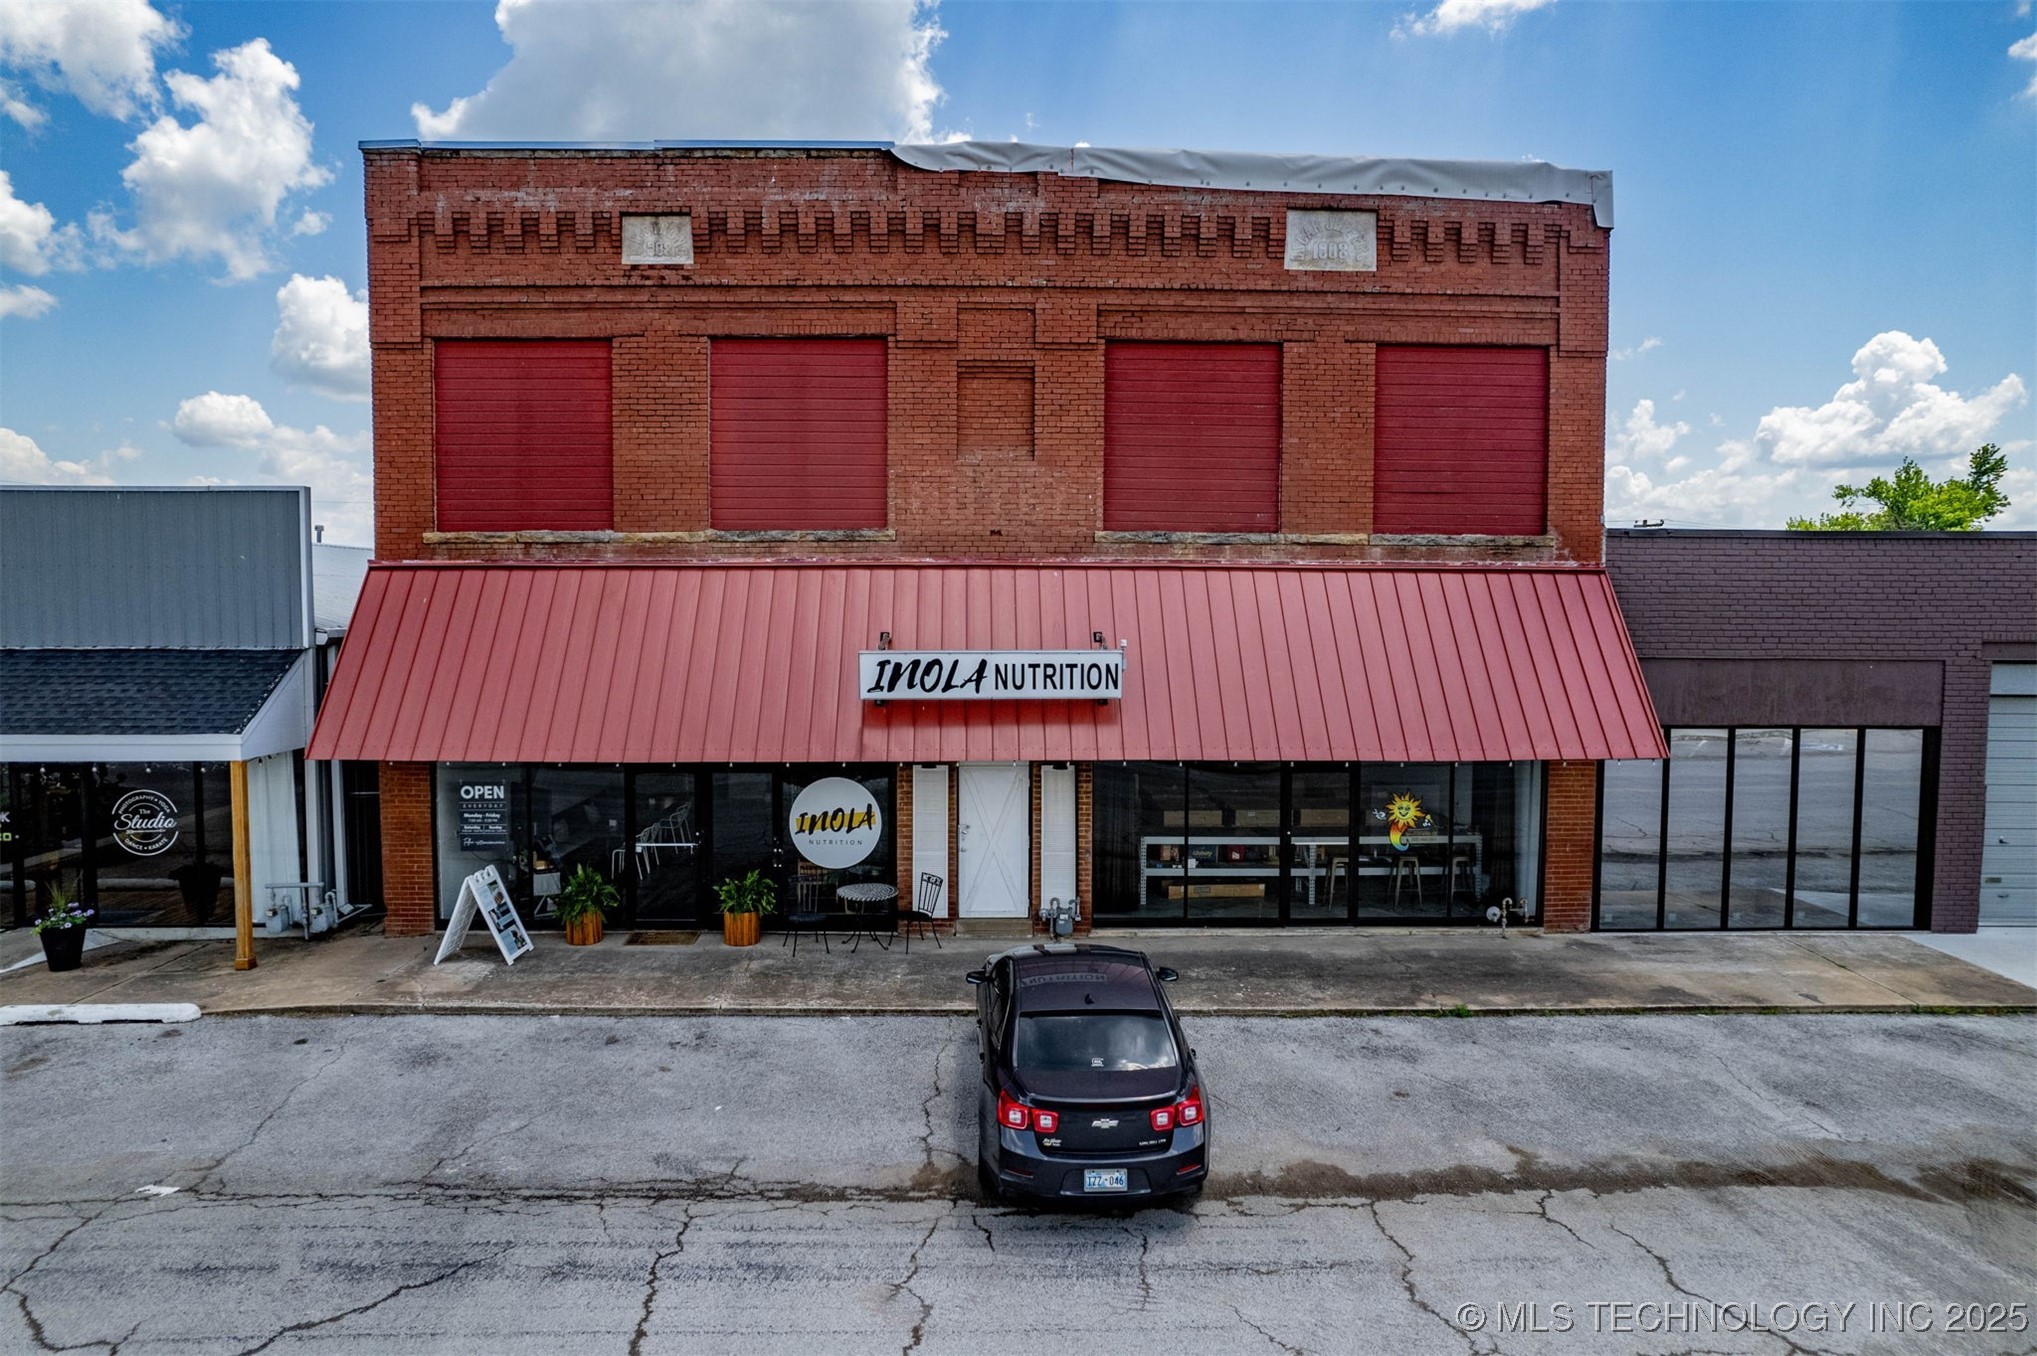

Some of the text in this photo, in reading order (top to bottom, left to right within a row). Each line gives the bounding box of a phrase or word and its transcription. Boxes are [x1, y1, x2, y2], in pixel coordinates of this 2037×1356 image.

[1312, 241, 1349, 260] 1908
[867, 658, 1119, 694] INOLA NUTRITION
[460, 785, 505, 799] OPEN
[118, 795, 171, 814] PHOTOGRAPHY YOGA
[113, 811, 178, 831] Studio
[794, 803, 875, 836] INOLA
[124, 837, 169, 851] DANCE KARATE
